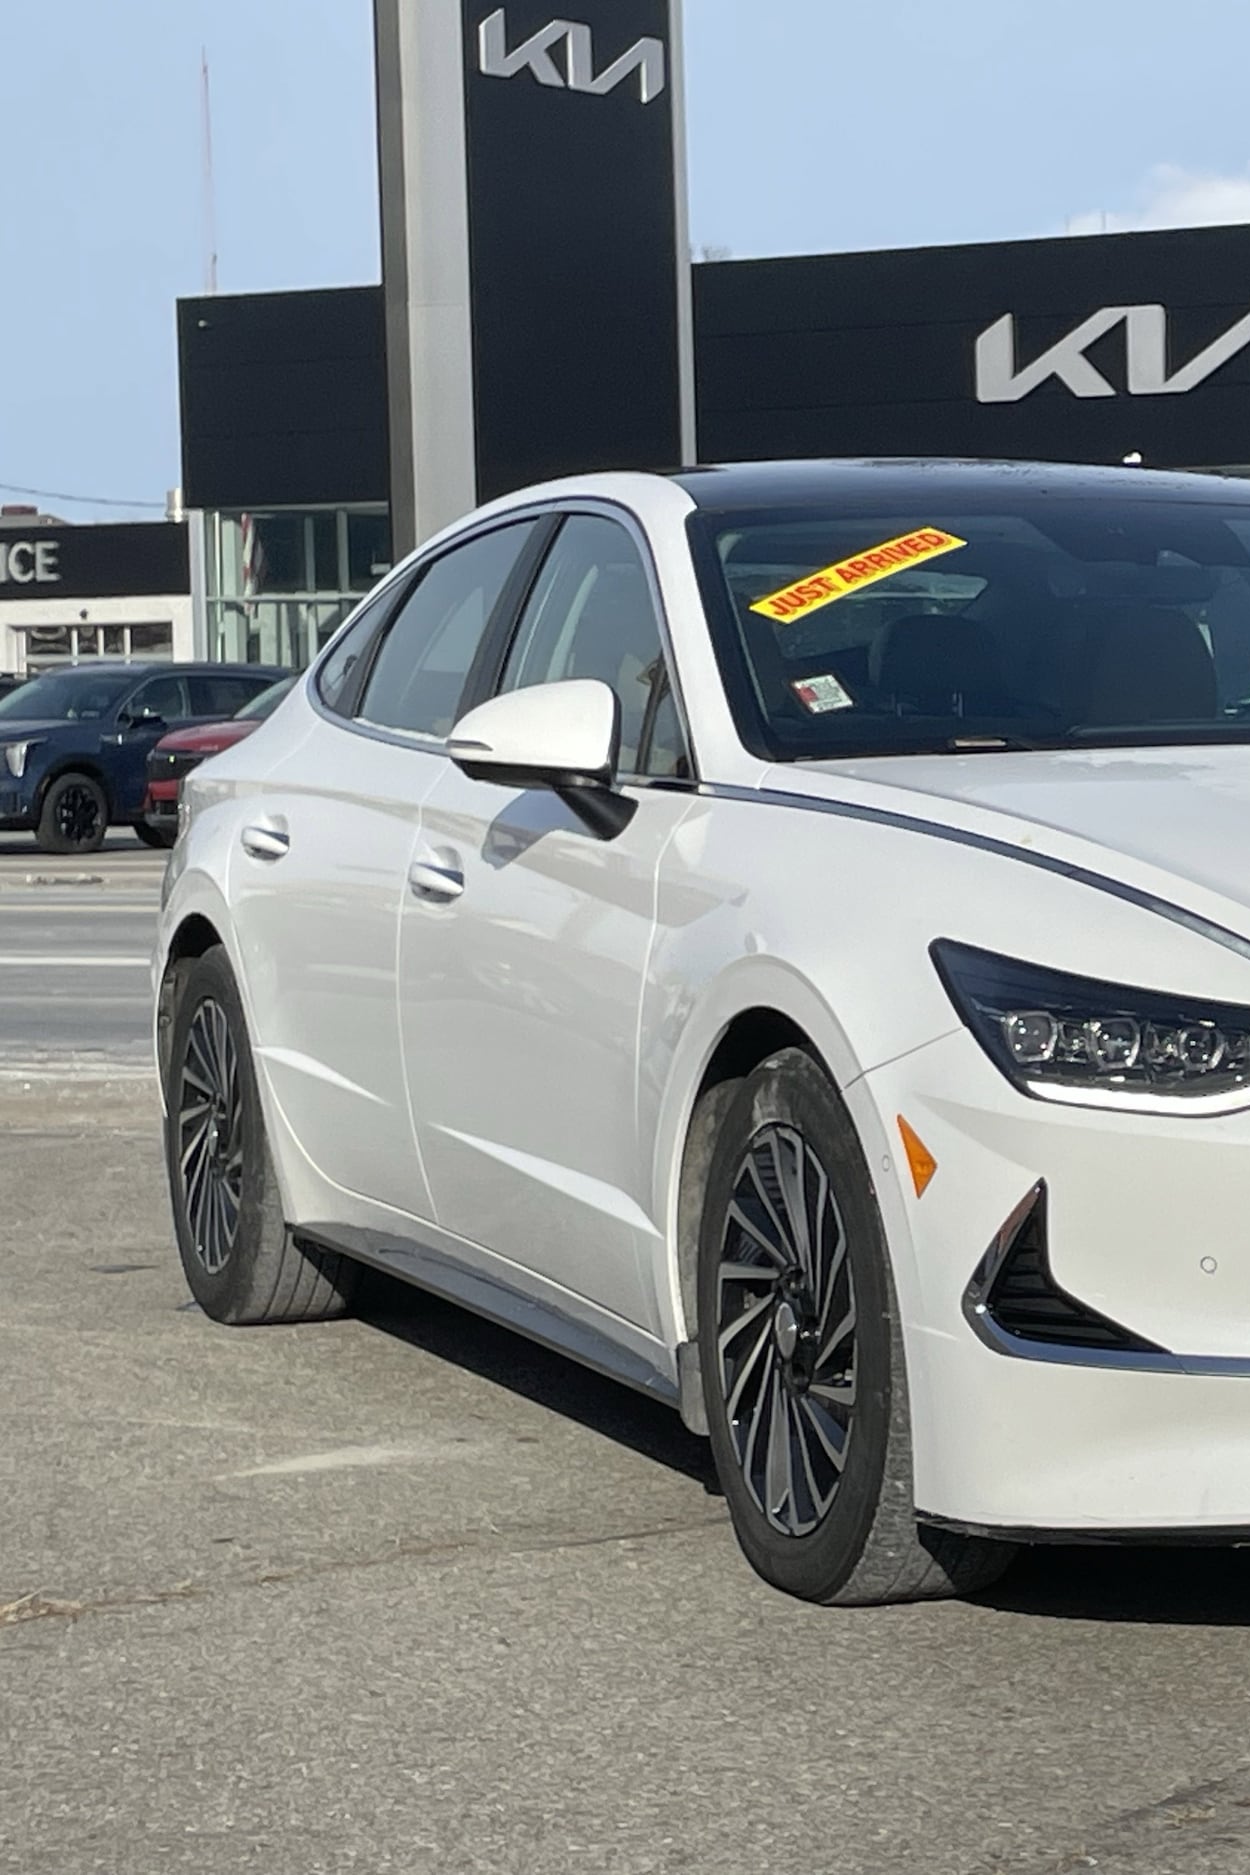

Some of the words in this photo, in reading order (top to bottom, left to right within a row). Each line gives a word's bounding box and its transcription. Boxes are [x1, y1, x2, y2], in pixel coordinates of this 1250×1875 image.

[479, 7, 665, 104] KIA
[769, 576, 838, 616] JUST
[835, 533, 946, 584] ARRIVED
